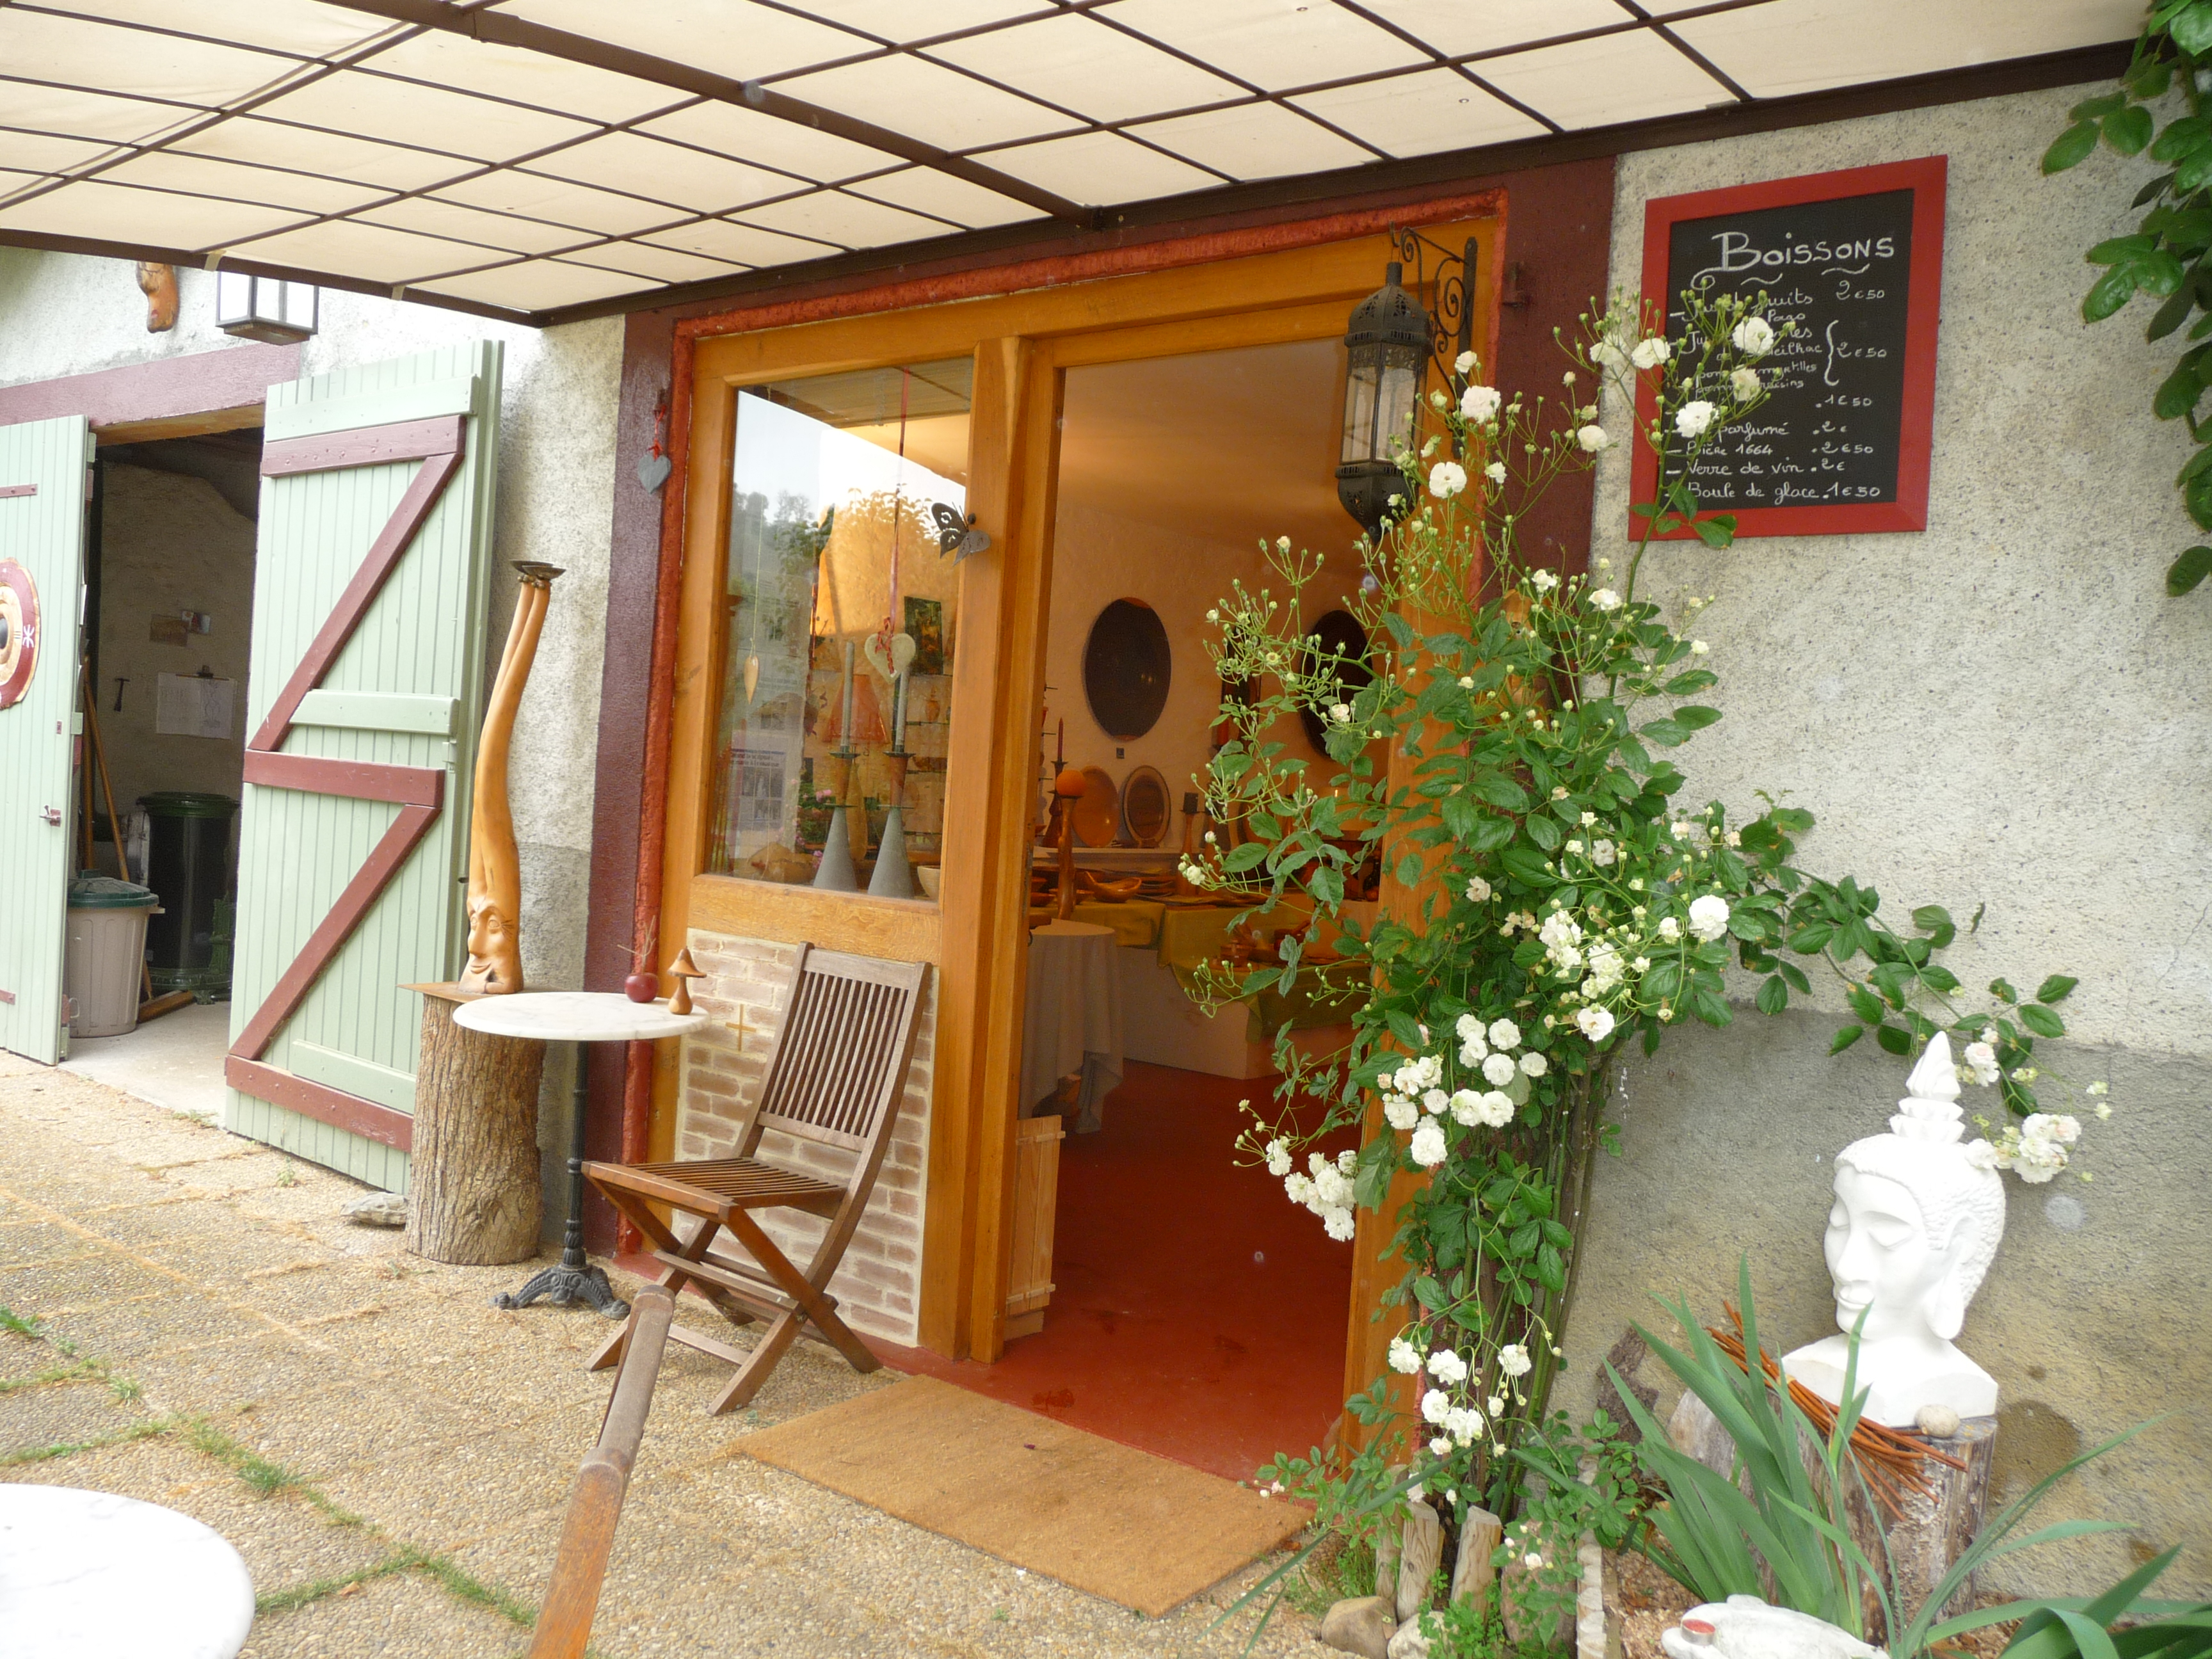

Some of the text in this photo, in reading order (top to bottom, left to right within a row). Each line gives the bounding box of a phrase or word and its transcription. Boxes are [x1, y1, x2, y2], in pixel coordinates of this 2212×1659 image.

[1736, 443, 1773, 455] 1664
[1740, 461, 1763, 474] de
[1688, 481, 1736, 497] Boule
[1746, 483, 1765, 497] de
[1775, 481, 1820, 505] glace
